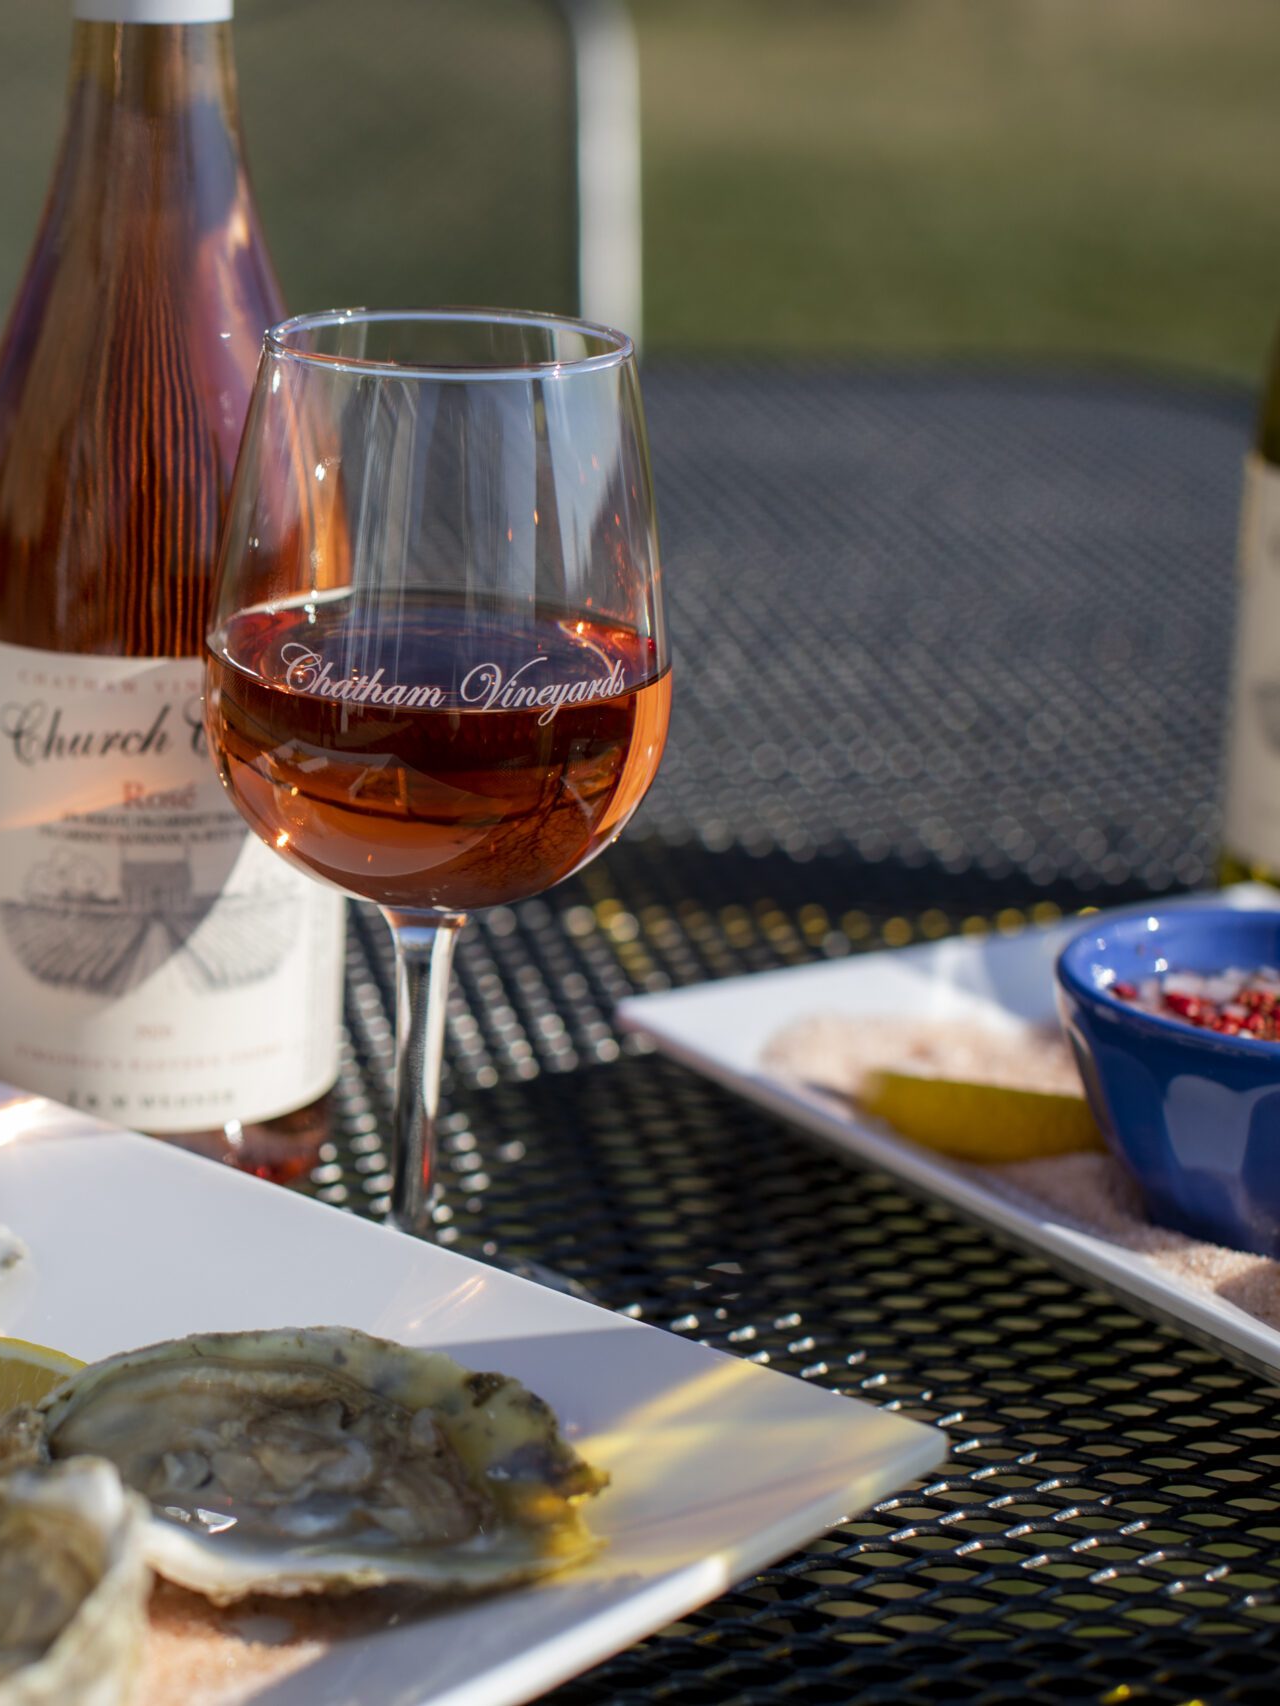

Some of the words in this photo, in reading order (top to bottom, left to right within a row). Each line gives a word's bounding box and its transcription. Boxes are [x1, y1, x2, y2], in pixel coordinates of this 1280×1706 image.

[280, 642, 447, 709] Chatham
[459, 656, 627, 727] Vineyards
[122, 779, 197, 810] Rosé
